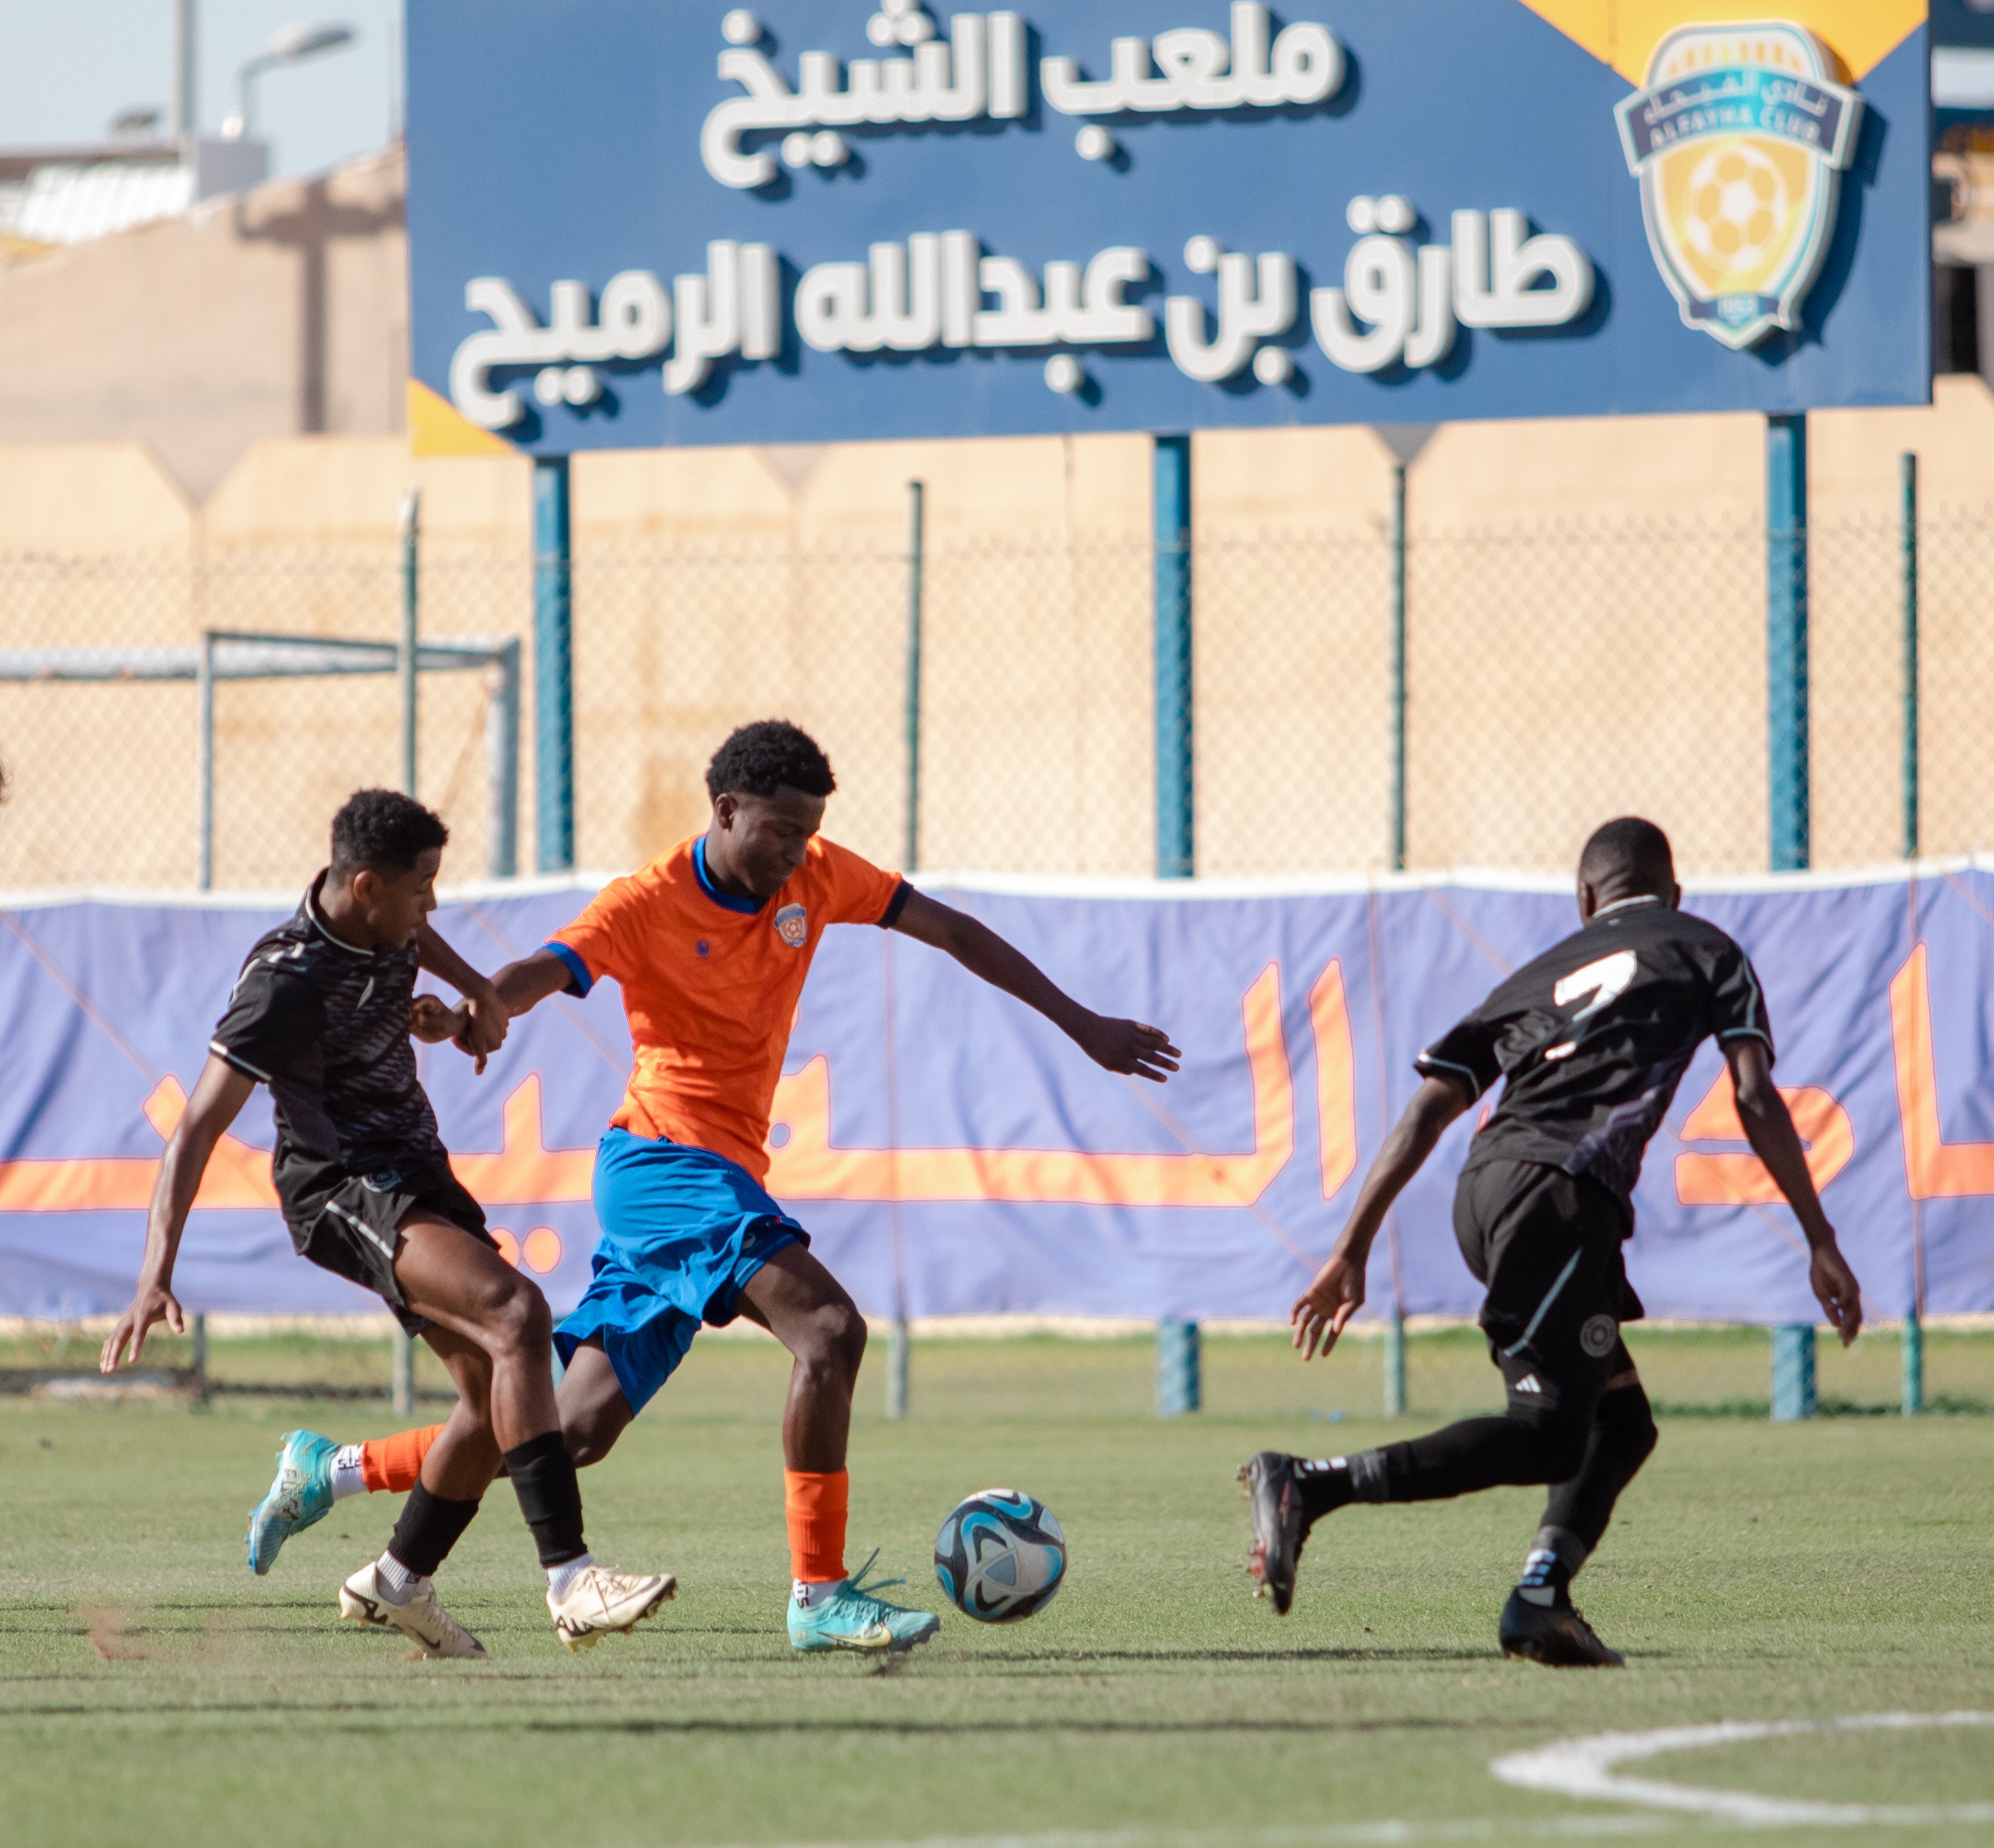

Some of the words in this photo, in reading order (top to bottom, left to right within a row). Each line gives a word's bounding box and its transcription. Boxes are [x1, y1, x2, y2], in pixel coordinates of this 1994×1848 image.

[700, 0, 1029, 188] الشيخ
[1040, 0, 1346, 160] ملعب
[1760, 105, 1821, 144] CLUB
[449, 239, 781, 430] الرميح
[794, 230, 1154, 394] عبدالله
[1165, 235, 1298, 385] بن
[1309, 195, 1595, 372] طارق
